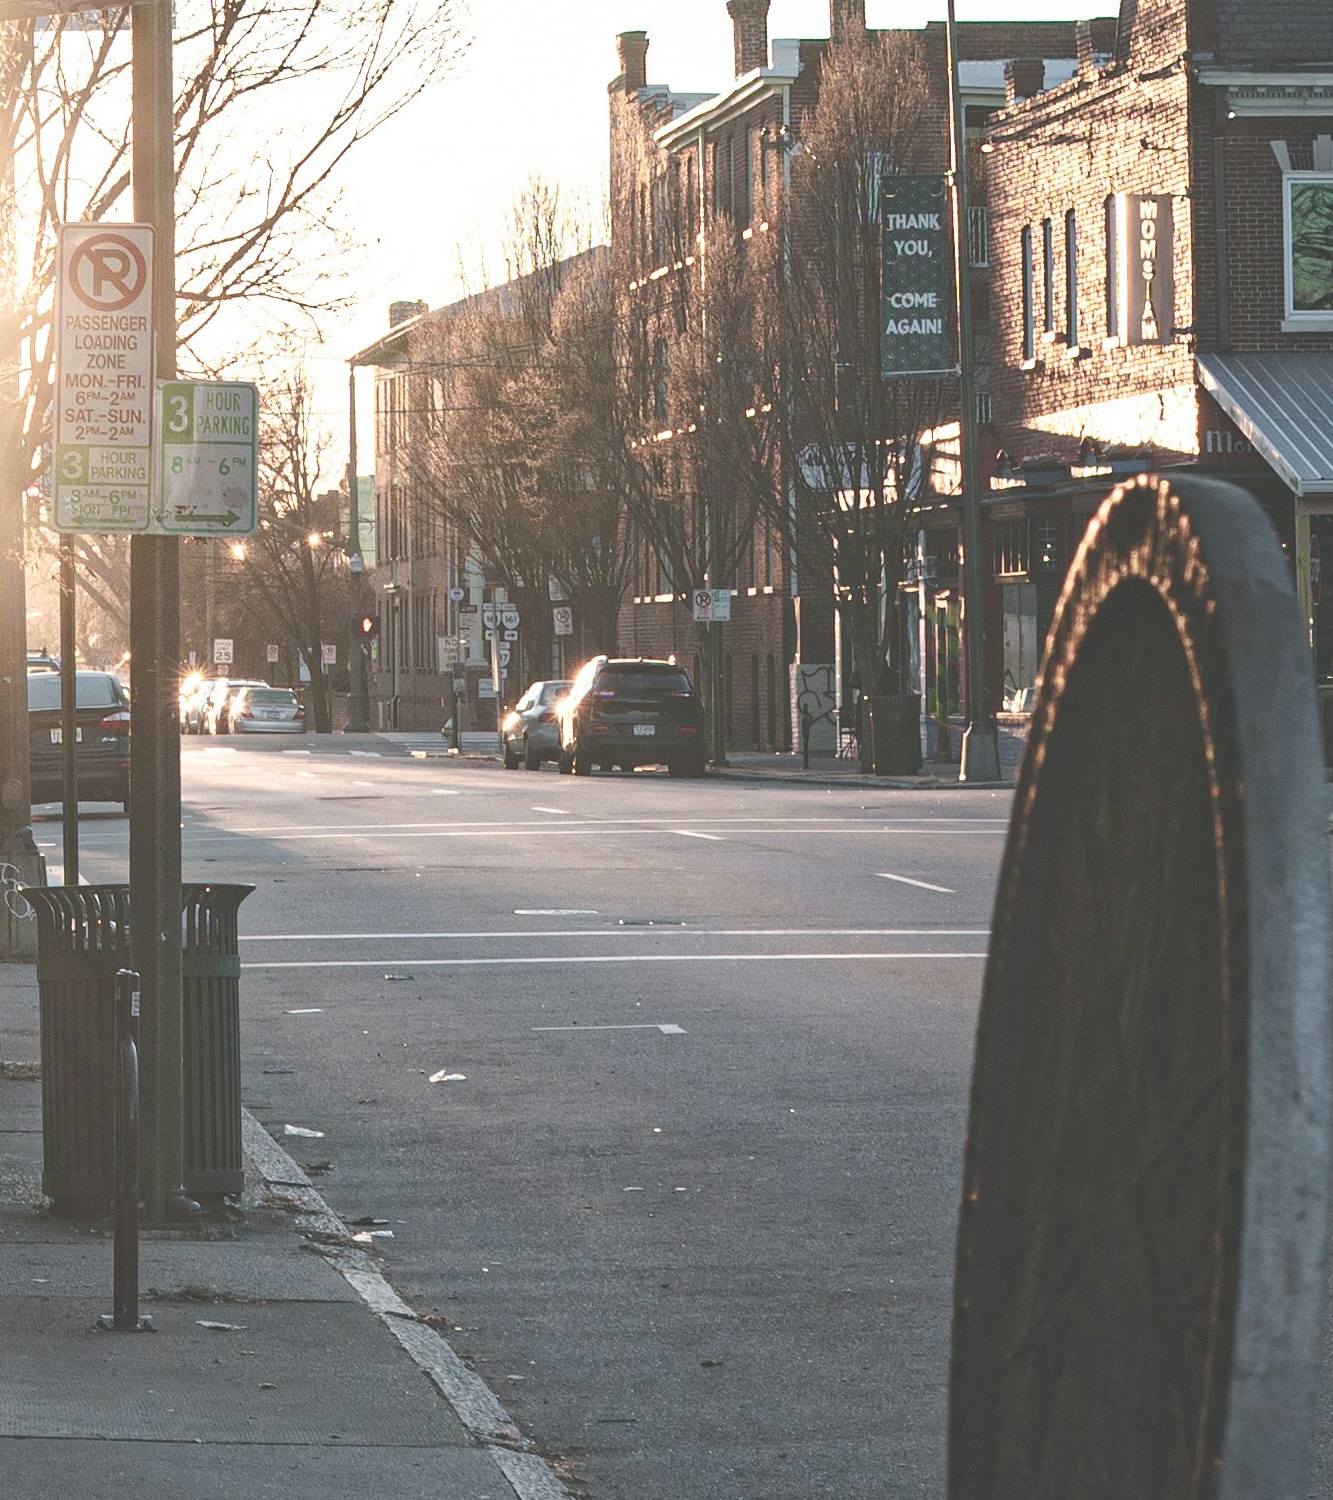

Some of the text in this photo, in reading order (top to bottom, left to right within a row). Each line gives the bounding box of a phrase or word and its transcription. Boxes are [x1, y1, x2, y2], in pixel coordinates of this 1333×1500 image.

[886, 213, 940, 229] THANK
[894, 240, 933, 258] YOU,
[890, 292, 937, 308] COME
[66, 315, 147, 332] PASSENGER
[885, 319, 943, 335] AGAIN!
[75, 334, 138, 350] LOADING
[86, 353, 126, 369] ZONE
[65, 373, 146, 389] MON.-FRI.
[64, 408, 147, 424] SAT.-SUN.
[168, 392, 241, 432] 3 HOUR
[198, 416, 250, 435] PARKING
[62, 451, 137, 479] 3 HOUR
[91, 466, 145, 479] PARKING
[215, 651, 231, 661] 25
